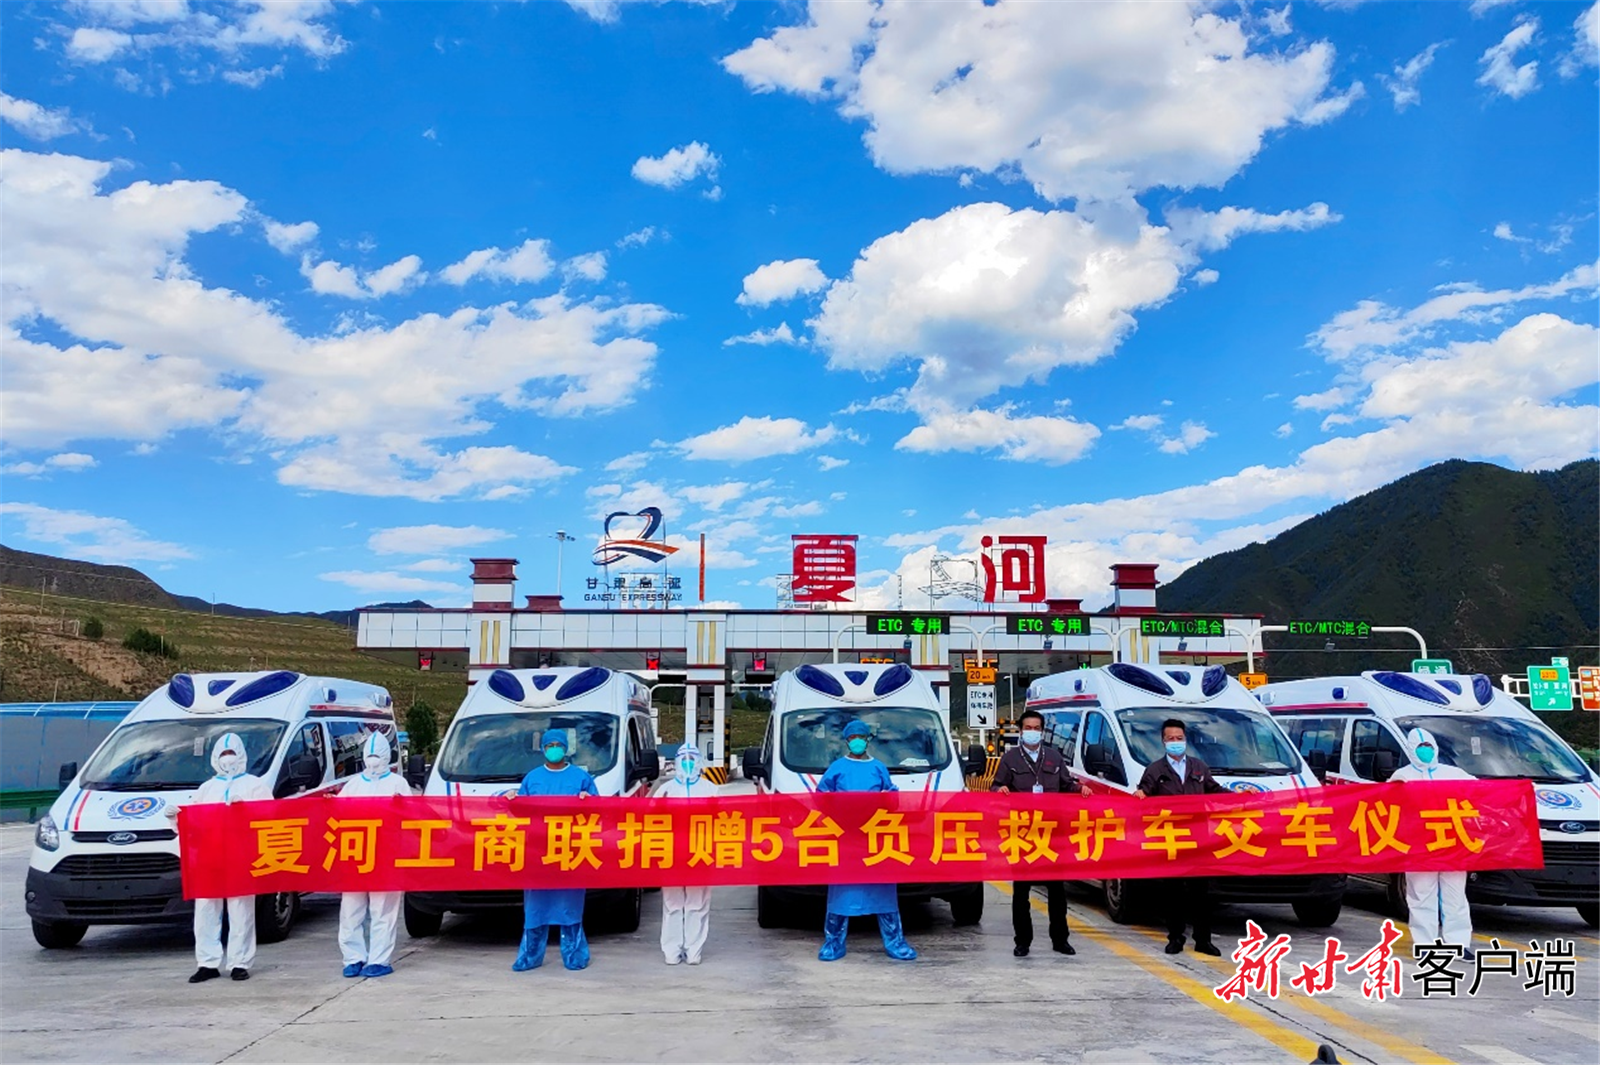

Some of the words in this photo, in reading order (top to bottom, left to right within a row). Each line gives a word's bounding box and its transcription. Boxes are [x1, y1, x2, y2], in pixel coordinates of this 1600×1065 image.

[584, 593, 616, 602] GANSU
[621, 593, 683, 602] EXPRESSWAY
[877, 618, 903, 632] ETC
[911, 617, 942, 634] 专用
[1018, 618, 1044, 632] ETC
[1051, 617, 1082, 634] 专用
[1142, 619, 1223, 634] ETC/MTC混合
[1289, 620, 1371, 636] ETC/MTC混合
[970, 670, 981, 680] 20
[1245, 676, 1251, 686] 5
[249, 799, 1485, 877] 夏河工商联捐赠5台负压救护车交车仪式
